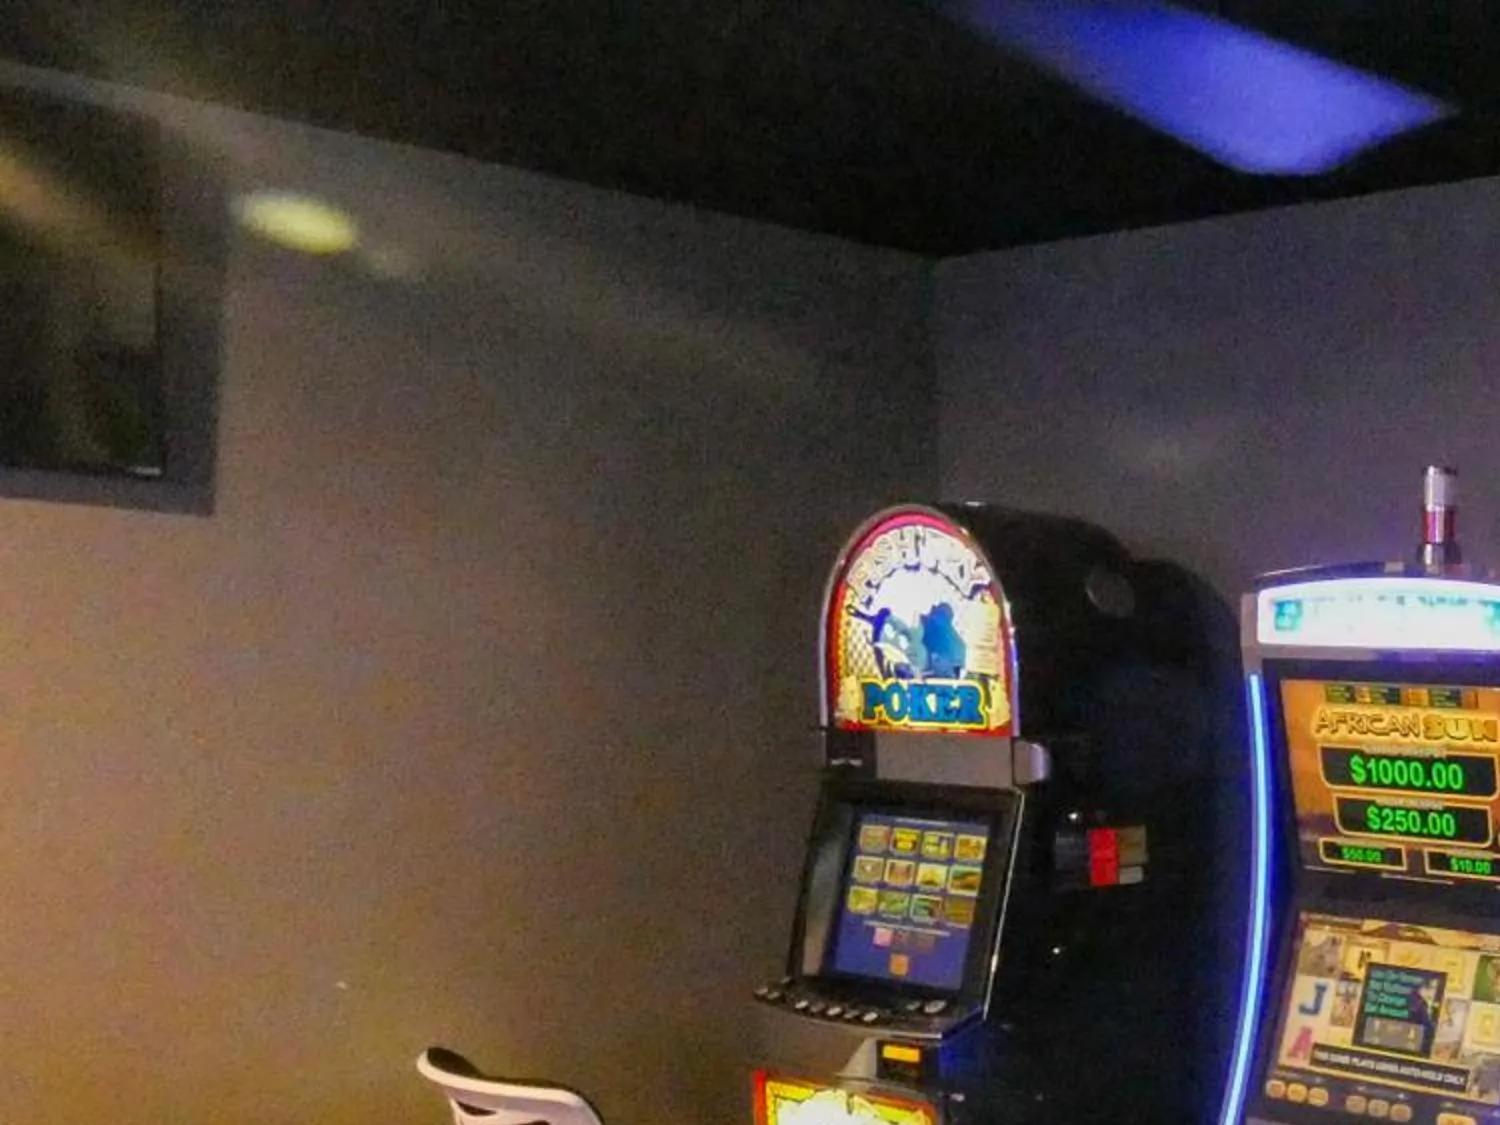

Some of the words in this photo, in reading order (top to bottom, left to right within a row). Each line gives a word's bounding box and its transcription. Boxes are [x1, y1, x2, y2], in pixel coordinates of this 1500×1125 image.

[863, 682, 985, 724] POKER
[1315, 709, 1420, 738] AFRICAN
[1422, 713, 1498, 742] SUN
[1349, 754, 1463, 790] $1000.00
[1367, 805, 1456, 837] $250.00
